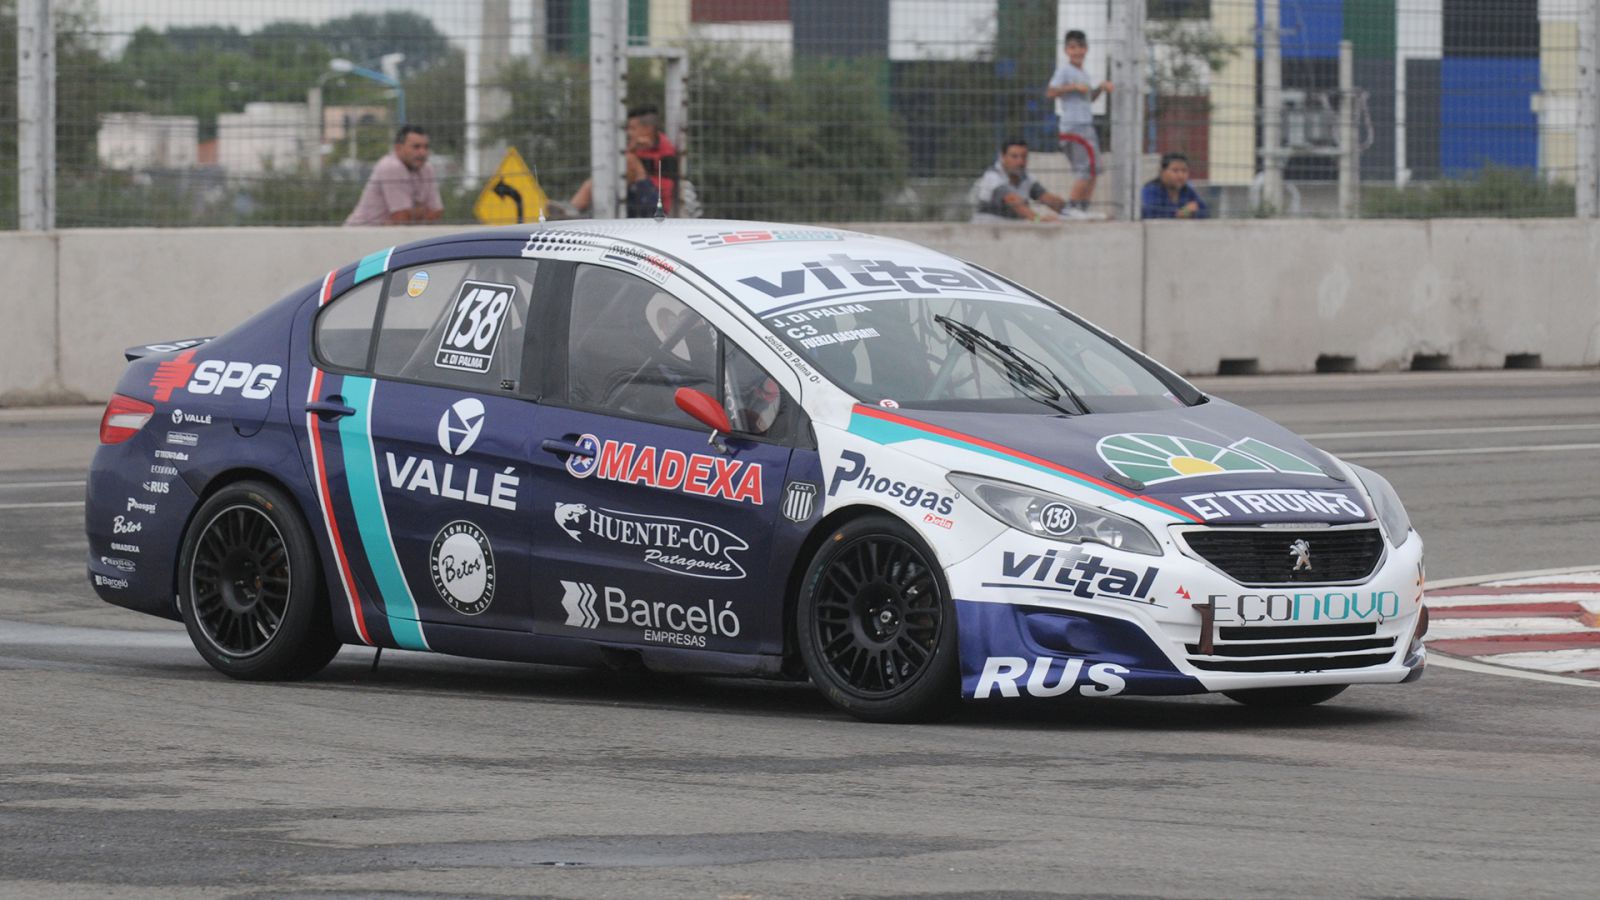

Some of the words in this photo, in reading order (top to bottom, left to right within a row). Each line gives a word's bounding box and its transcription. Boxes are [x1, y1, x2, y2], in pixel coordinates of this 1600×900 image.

[736, 253, 1006, 299] vittal
[445, 288, 509, 351] 138
[774, 318, 790, 328] J.
[787, 312, 811, 323] DI
[808, 304, 872, 319] PALMA
[786, 324, 818, 339] C3
[800, 334, 838, 349] FUERZA
[442, 354, 449, 363] J.
[449, 354, 458, 365] DI
[458, 355, 483, 368] PALMA
[783, 349, 793, 360] Di
[791, 356, 811, 376] Palma
[187, 360, 282, 399] SPG
[184, 415, 212, 424] VALLÉ
[386, 452, 520, 511] VALLÉ
[597, 440, 763, 505] MADEXA
[827, 449, 954, 515] Phosgas
[150, 481, 169, 493] RUS
[1214, 488, 1366, 518] TRIUNFO
[113, 515, 142, 534] Betos
[588, 508, 720, 556] HUENTE-CO
[1045, 507, 1071, 529] 138
[442, 555, 481, 583] Betos
[644, 549, 732, 571] Patagonia
[1001, 546, 1160, 600] vittal
[604, 586, 740, 638] Barceló
[644, 629, 706, 648] EMPRESAS
[973, 656, 1130, 699] RUS
